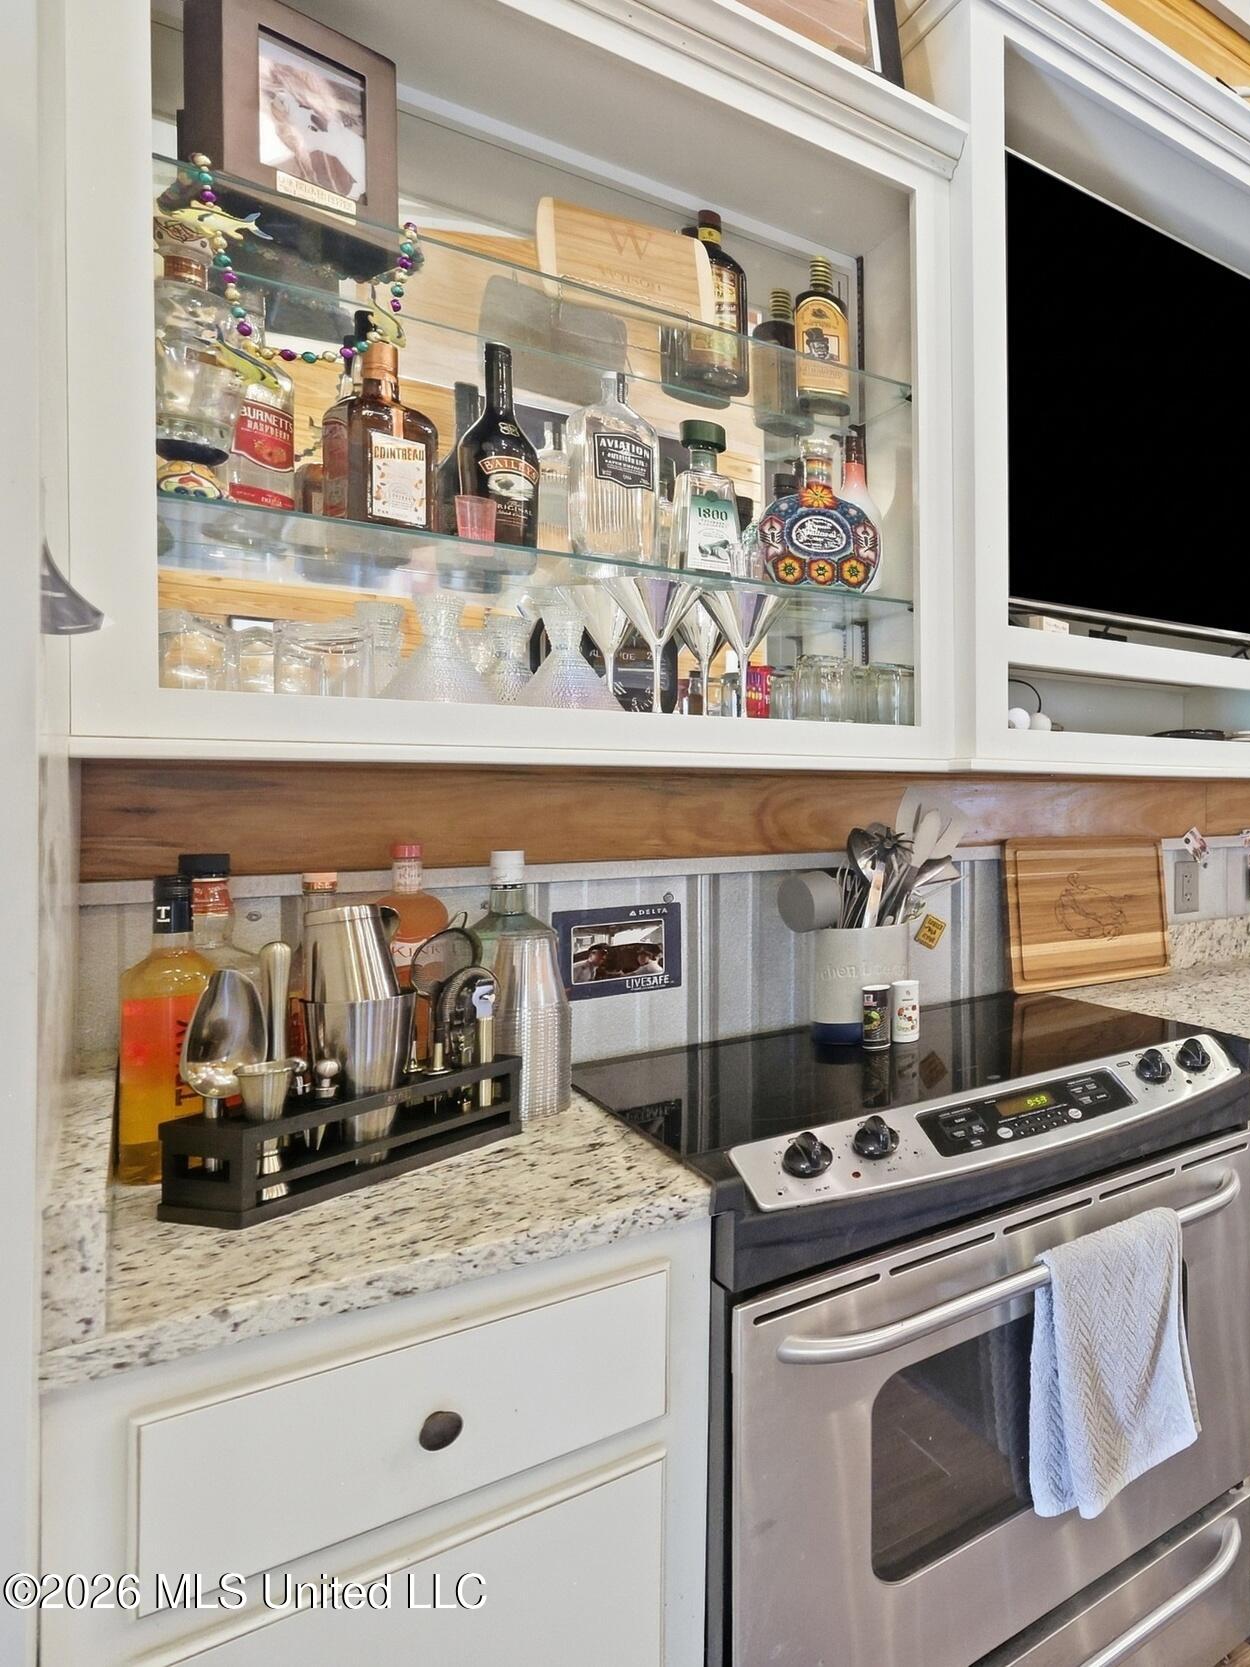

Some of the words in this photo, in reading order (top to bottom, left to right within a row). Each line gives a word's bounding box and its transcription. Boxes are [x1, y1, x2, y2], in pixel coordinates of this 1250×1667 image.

[374, 446, 425, 461] COINTREAU
[600, 438, 650, 459] AVIATION
[484, 459, 537, 480] BAILEYS
[698, 507, 728, 521] 1800
[638, 907, 668, 916] DELTA
[625, 975, 670, 989] LIVESAFE
